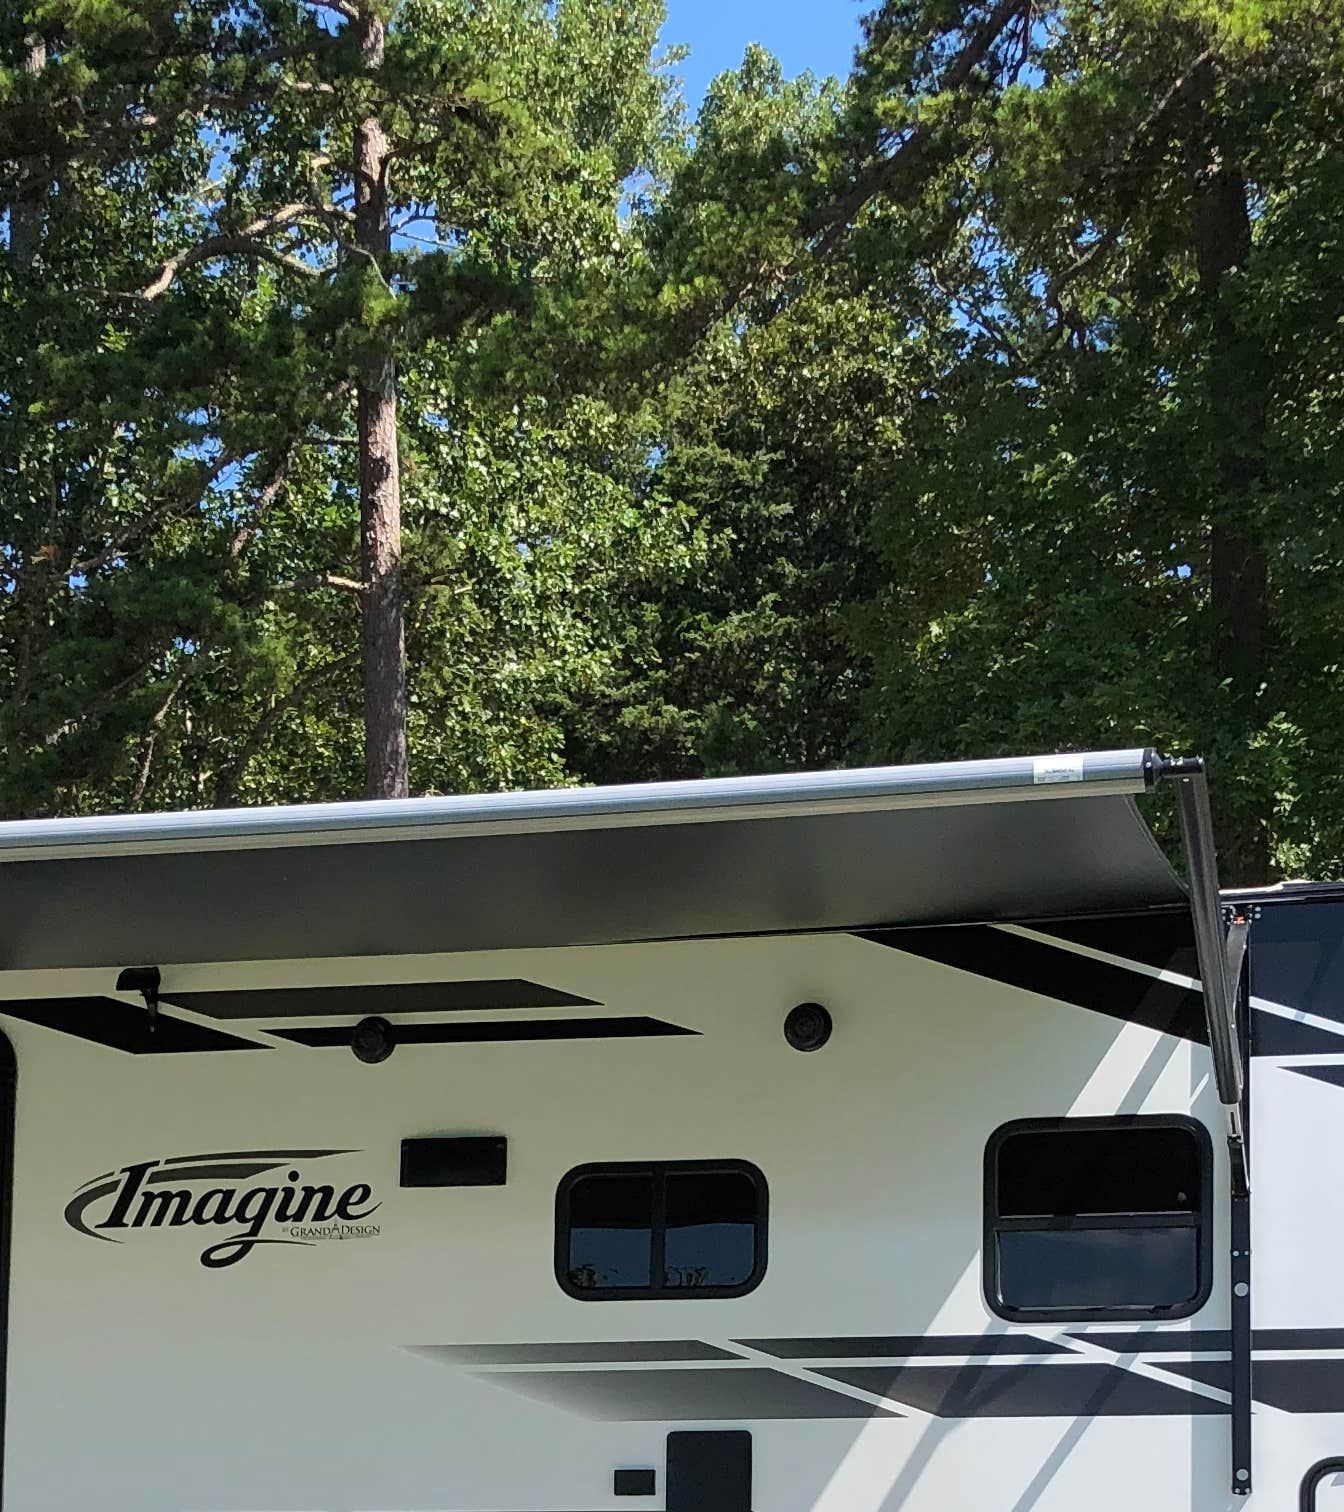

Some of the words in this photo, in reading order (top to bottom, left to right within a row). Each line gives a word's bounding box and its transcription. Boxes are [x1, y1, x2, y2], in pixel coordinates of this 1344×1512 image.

[94, 1160, 383, 1268] Imagine
[290, 1226, 331, 1238] GRAND
[341, 1225, 381, 1236] DESIGN
